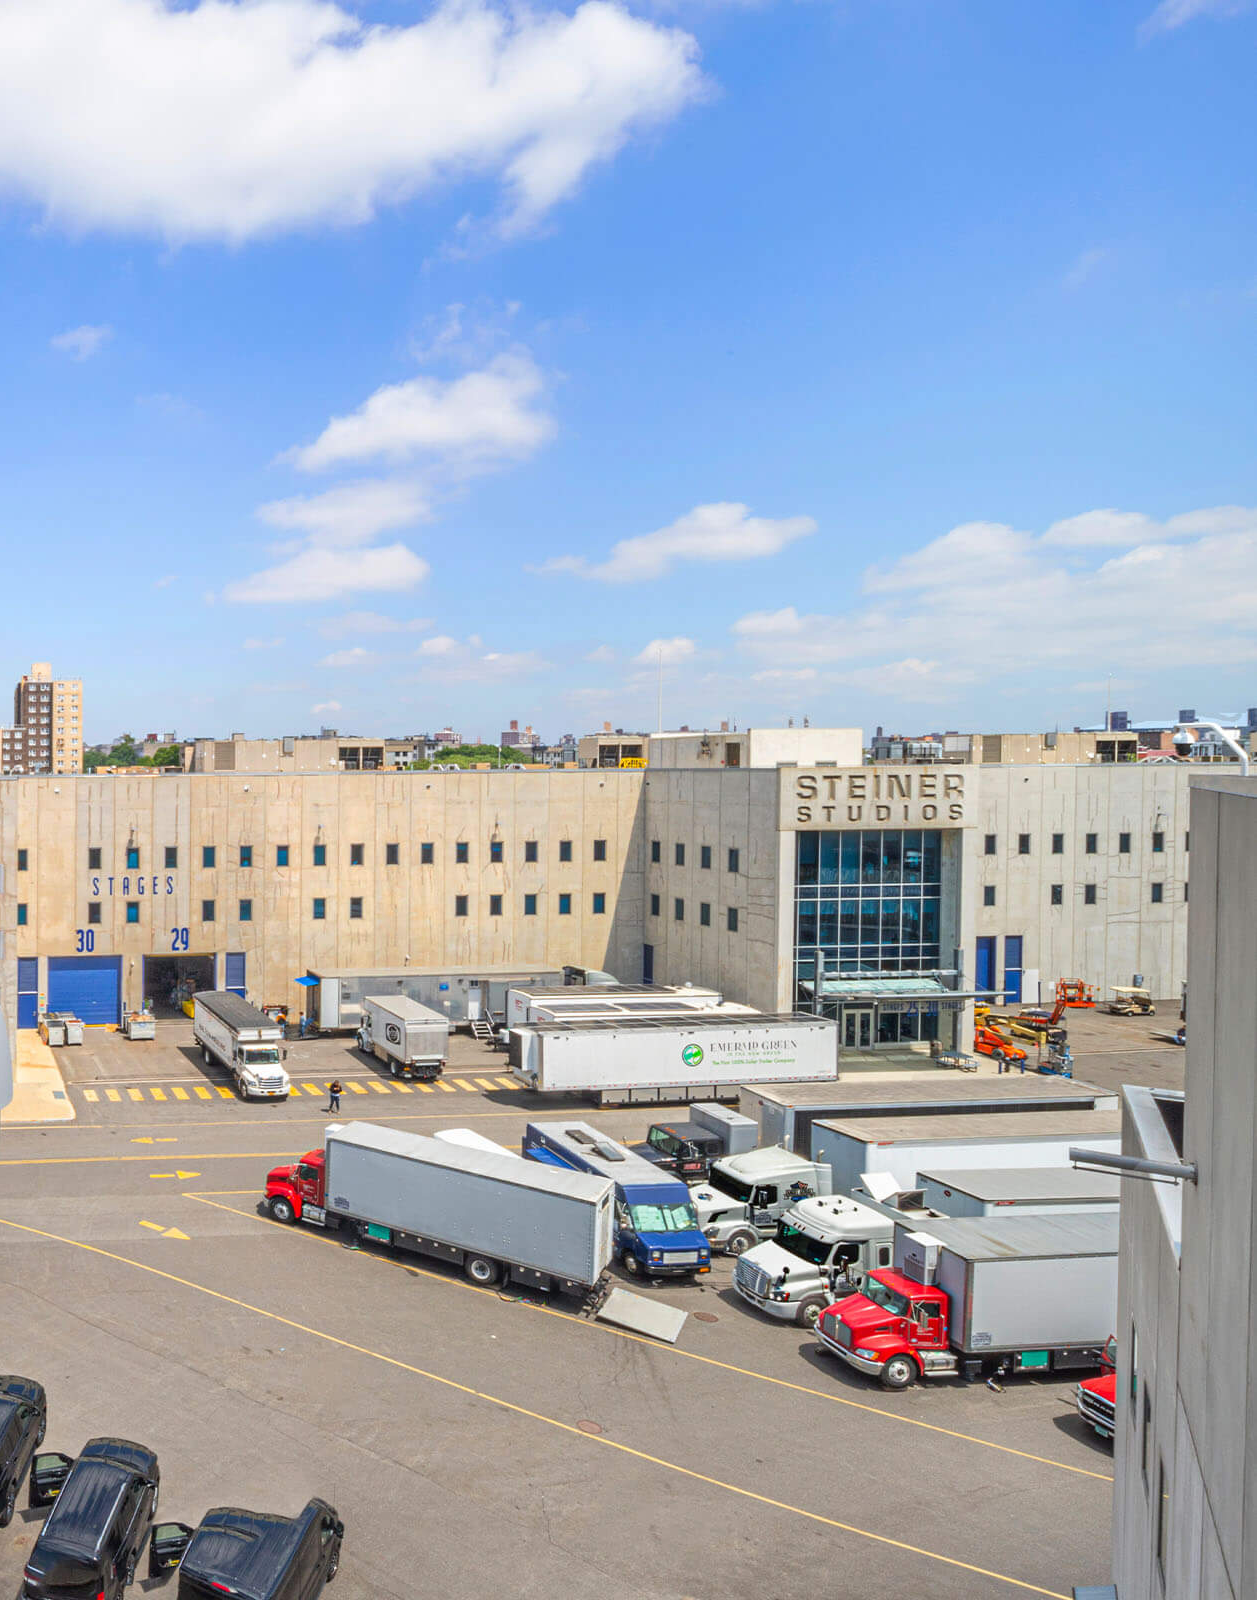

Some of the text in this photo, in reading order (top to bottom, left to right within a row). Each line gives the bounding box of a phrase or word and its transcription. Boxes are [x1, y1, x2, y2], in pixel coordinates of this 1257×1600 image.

[796, 774, 964, 801] STEINER
[797, 804, 964, 823] STUDIOS
[92, 876, 174, 896] STAGES
[76, 929, 95, 952] 30
[171, 927, 189, 951] 29
